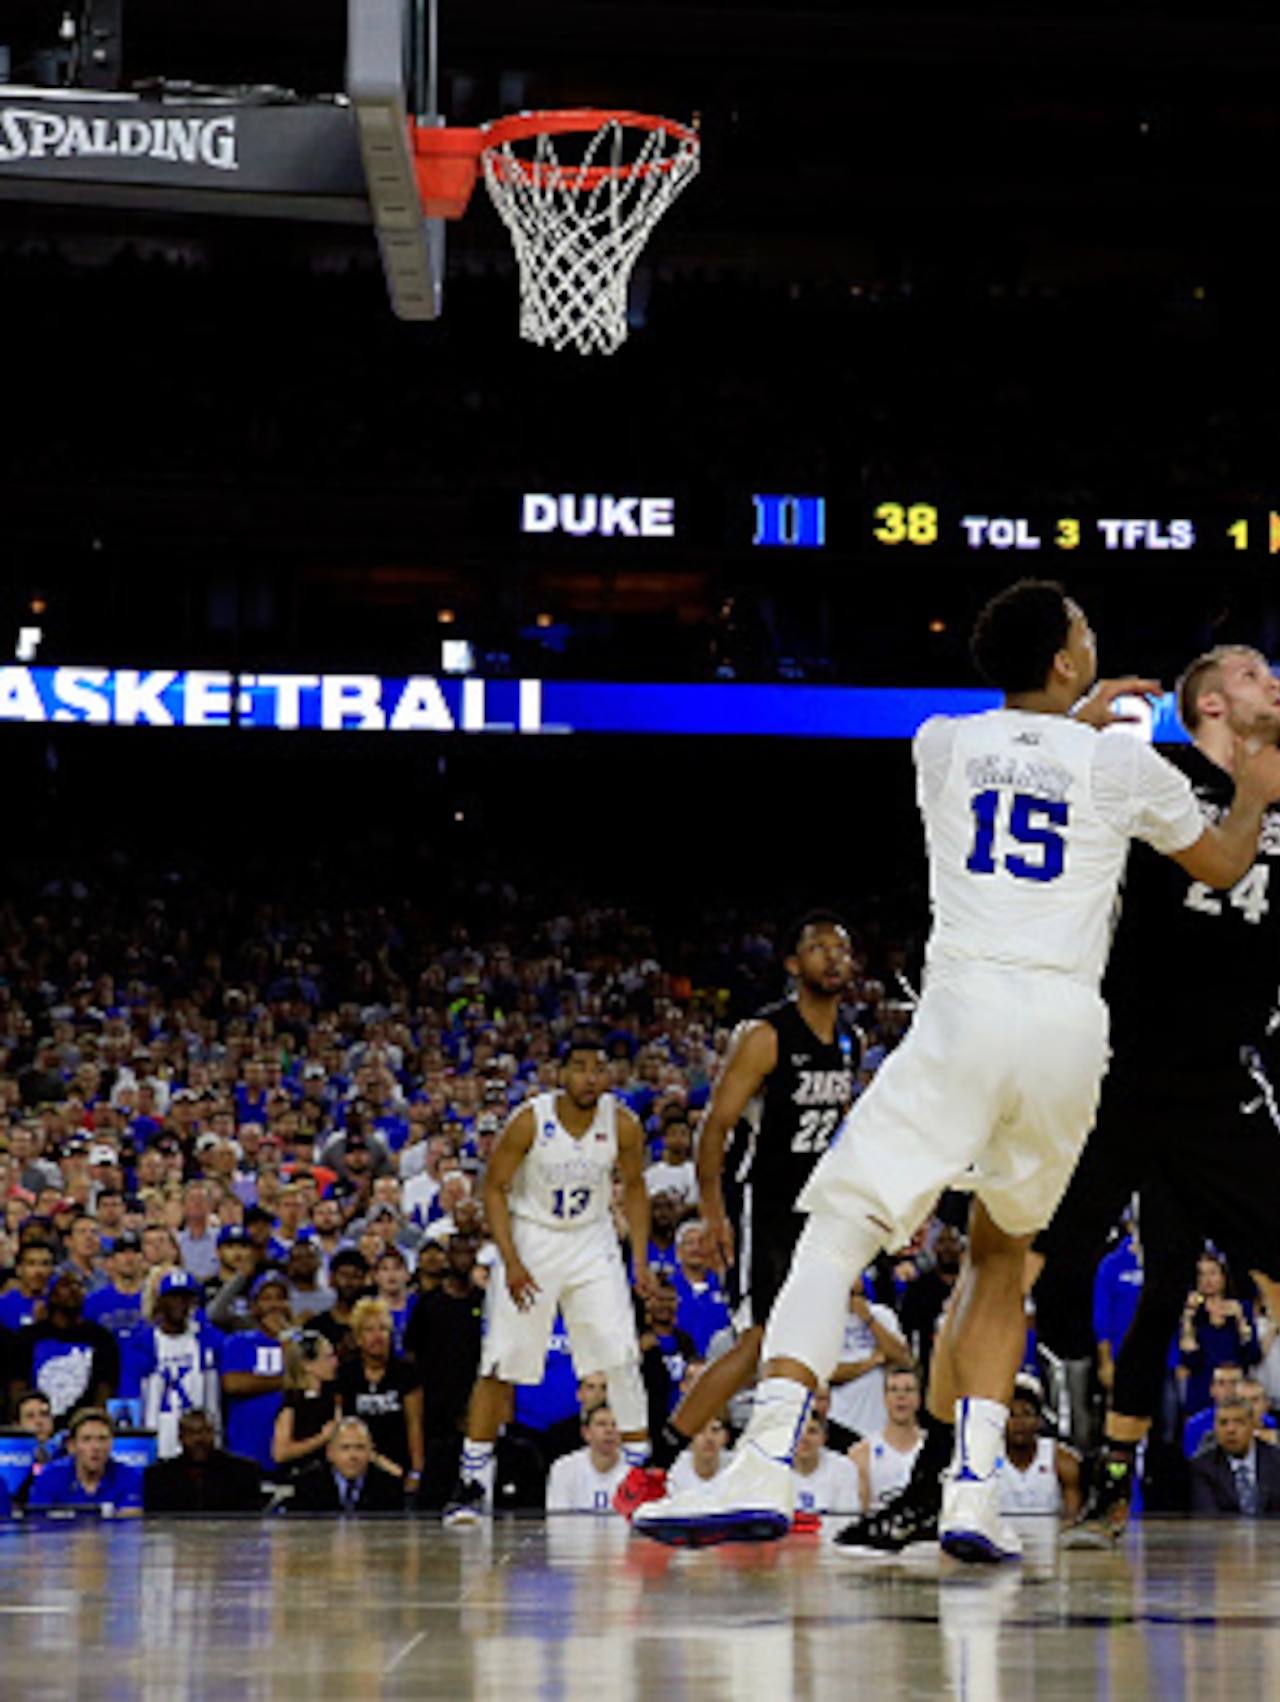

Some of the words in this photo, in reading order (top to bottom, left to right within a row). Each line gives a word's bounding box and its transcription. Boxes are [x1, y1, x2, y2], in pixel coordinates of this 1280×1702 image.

[0, 108, 239, 170] SPALDING
[522, 494, 675, 536] DUKE
[873, 503, 938, 545] 38
[961, 515, 1040, 550] TOL
[1055, 518, 1080, 550] 3
[1098, 518, 1195, 550] TFLS
[1227, 518, 1249, 550] 1
[0, 666, 572, 734] ASKETBALL
[966, 789, 1069, 883] 15
[791, 1109, 840, 1153] 22
[551, 1187, 592, 1219] 13
